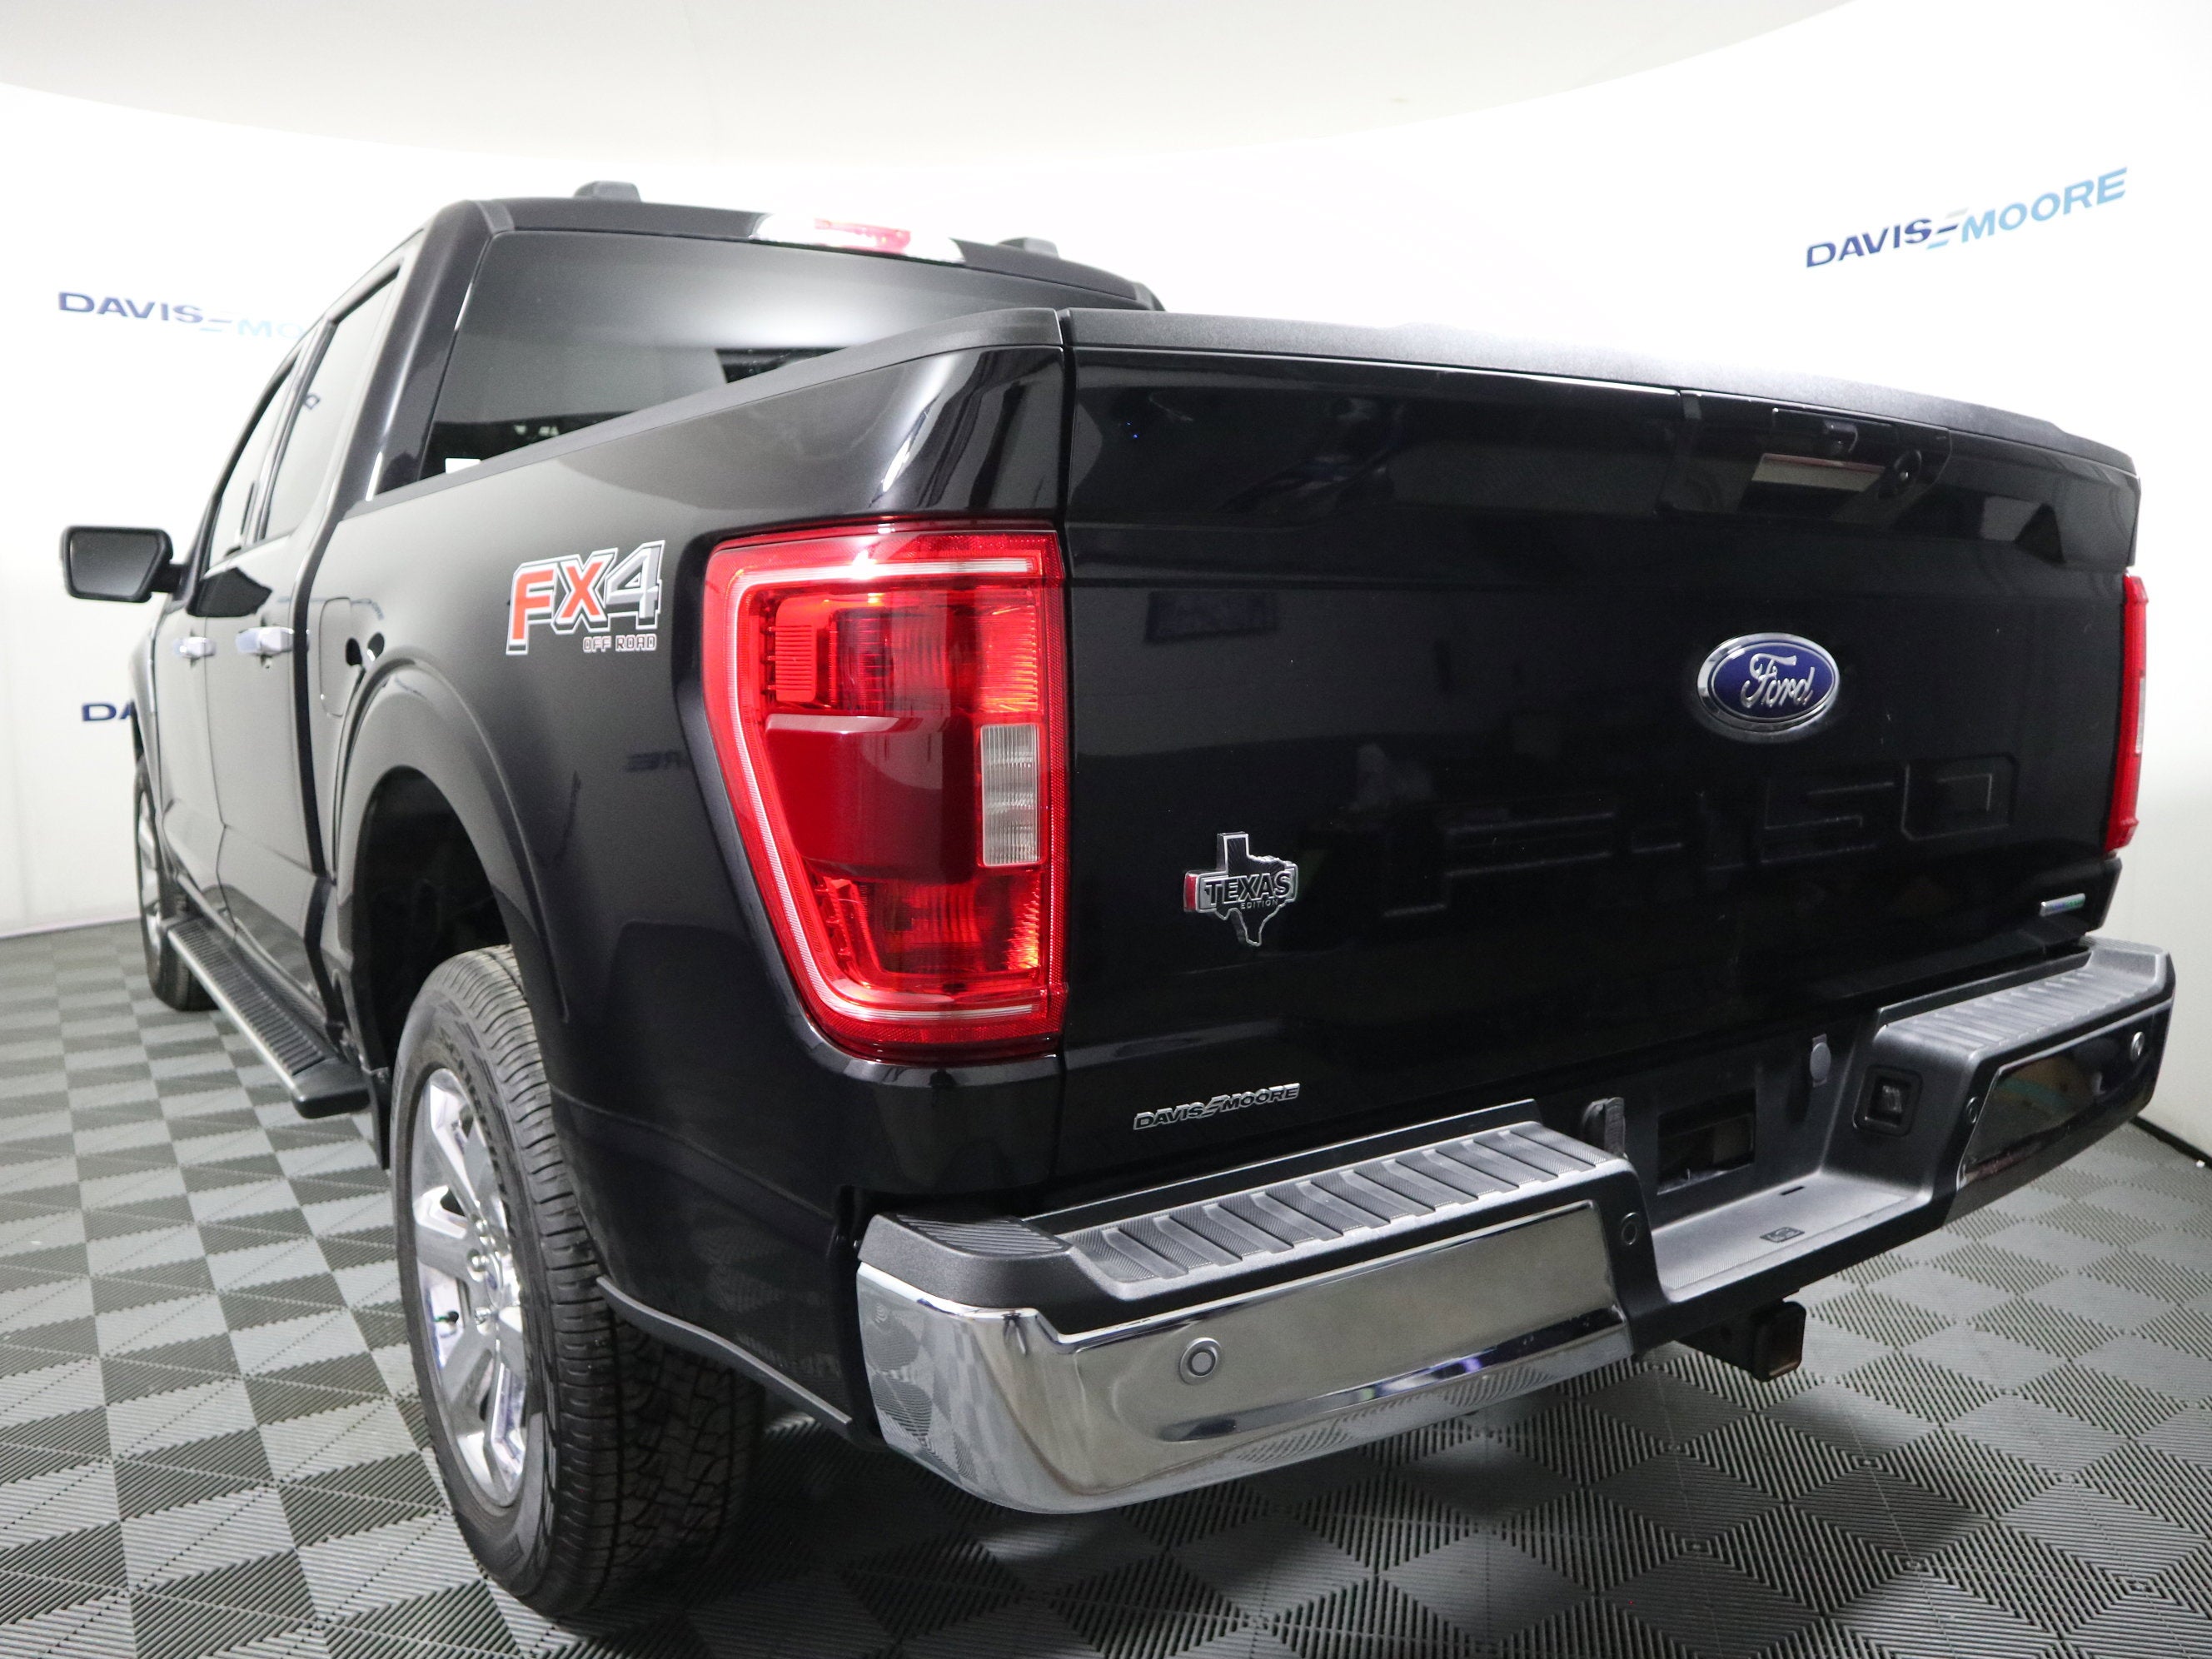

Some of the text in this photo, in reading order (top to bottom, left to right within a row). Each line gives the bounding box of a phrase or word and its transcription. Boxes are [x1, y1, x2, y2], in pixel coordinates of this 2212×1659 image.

[57, 291, 203, 324] DAVIS
[506, 540, 665, 655] FX4
[583, 634, 657, 653] OFF ROAD
[1740, 653, 1816, 708] Ford
[1203, 871, 1293, 906] TEXAS
[1239, 899, 1278, 910] EDITION
